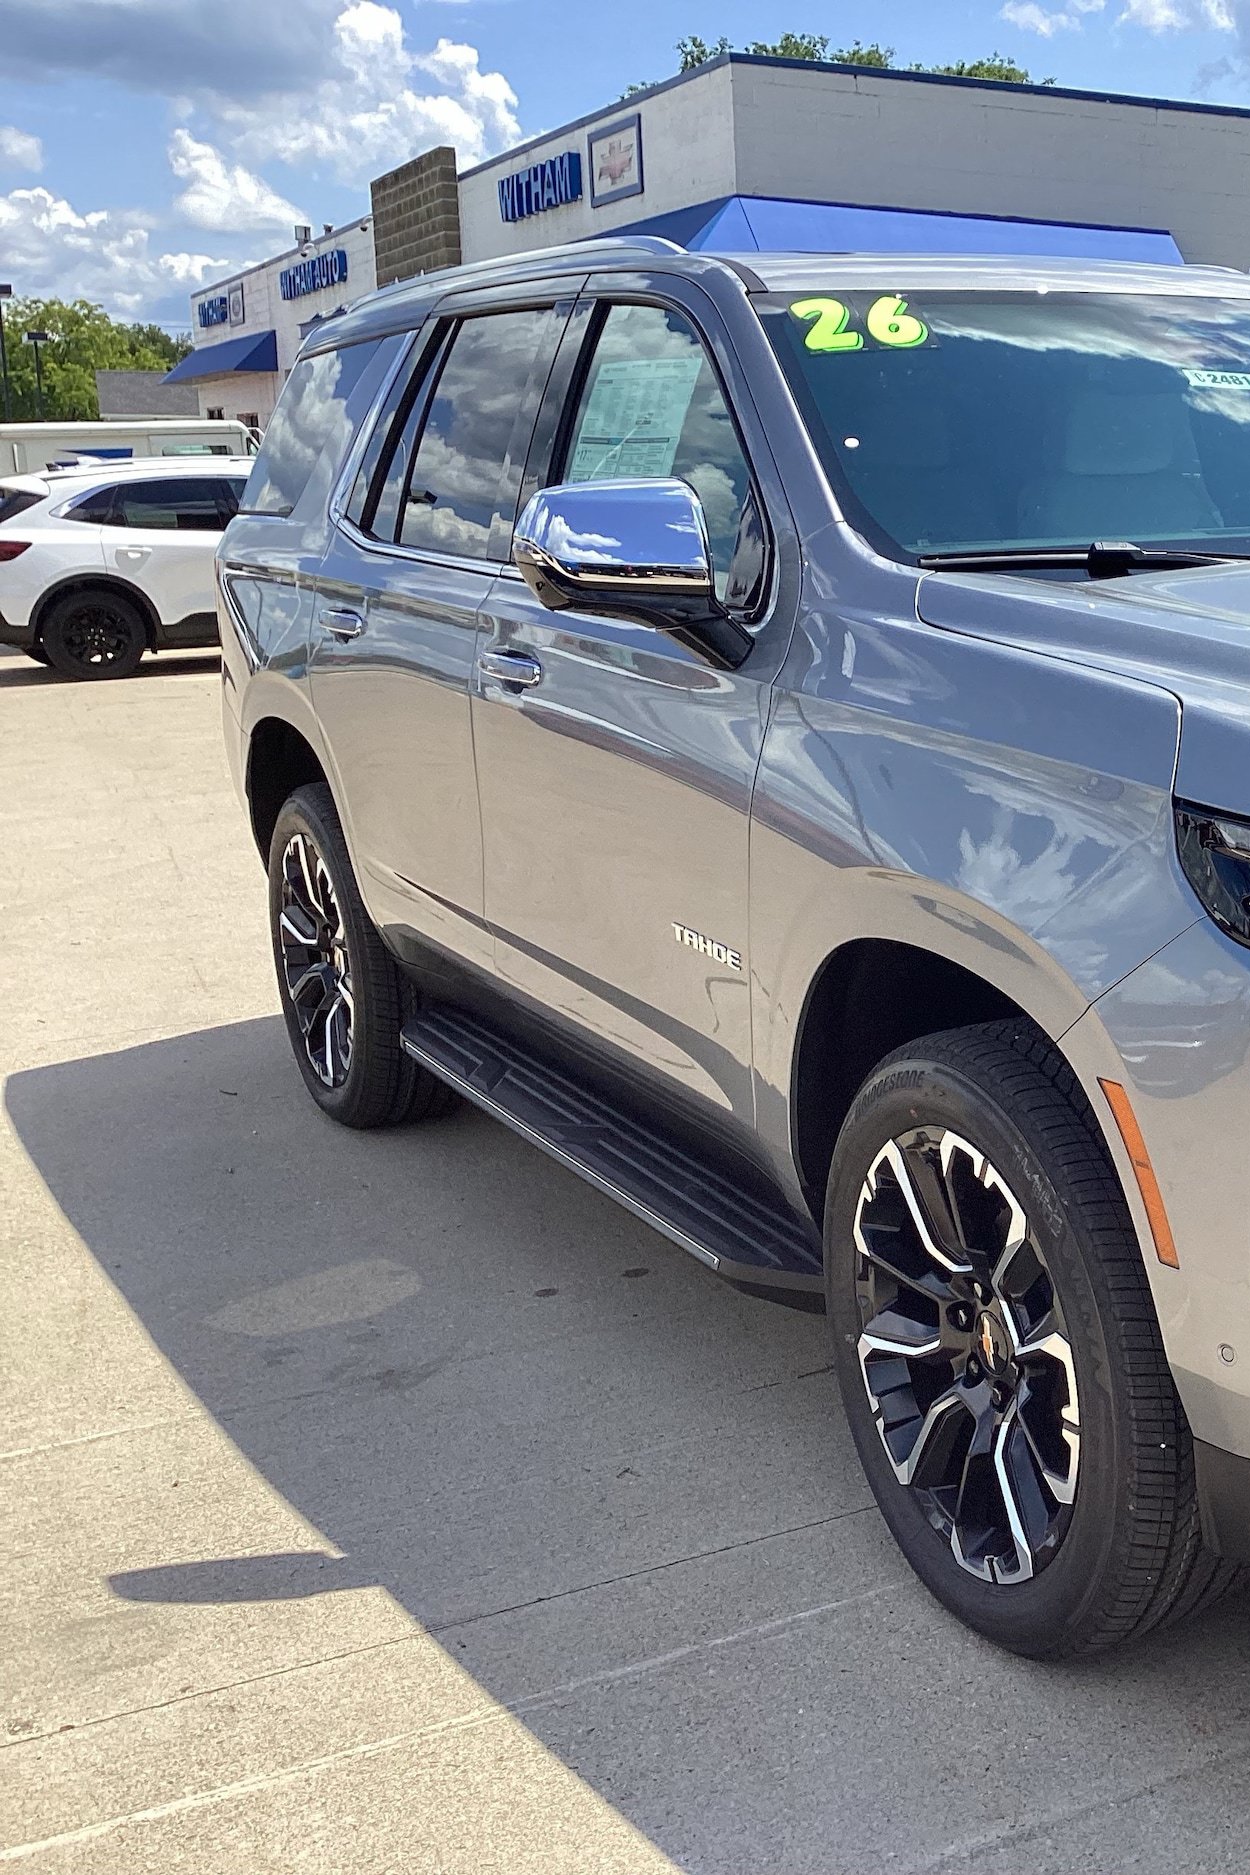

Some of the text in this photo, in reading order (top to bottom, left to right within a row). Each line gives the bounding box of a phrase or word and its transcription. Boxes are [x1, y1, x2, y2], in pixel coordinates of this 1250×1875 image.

[498, 152, 577, 222] WITHAM
[280, 250, 344, 300] WITHAM AUTO
[789, 296, 928, 352] 26
[670, 921, 742, 971] TAHOE
